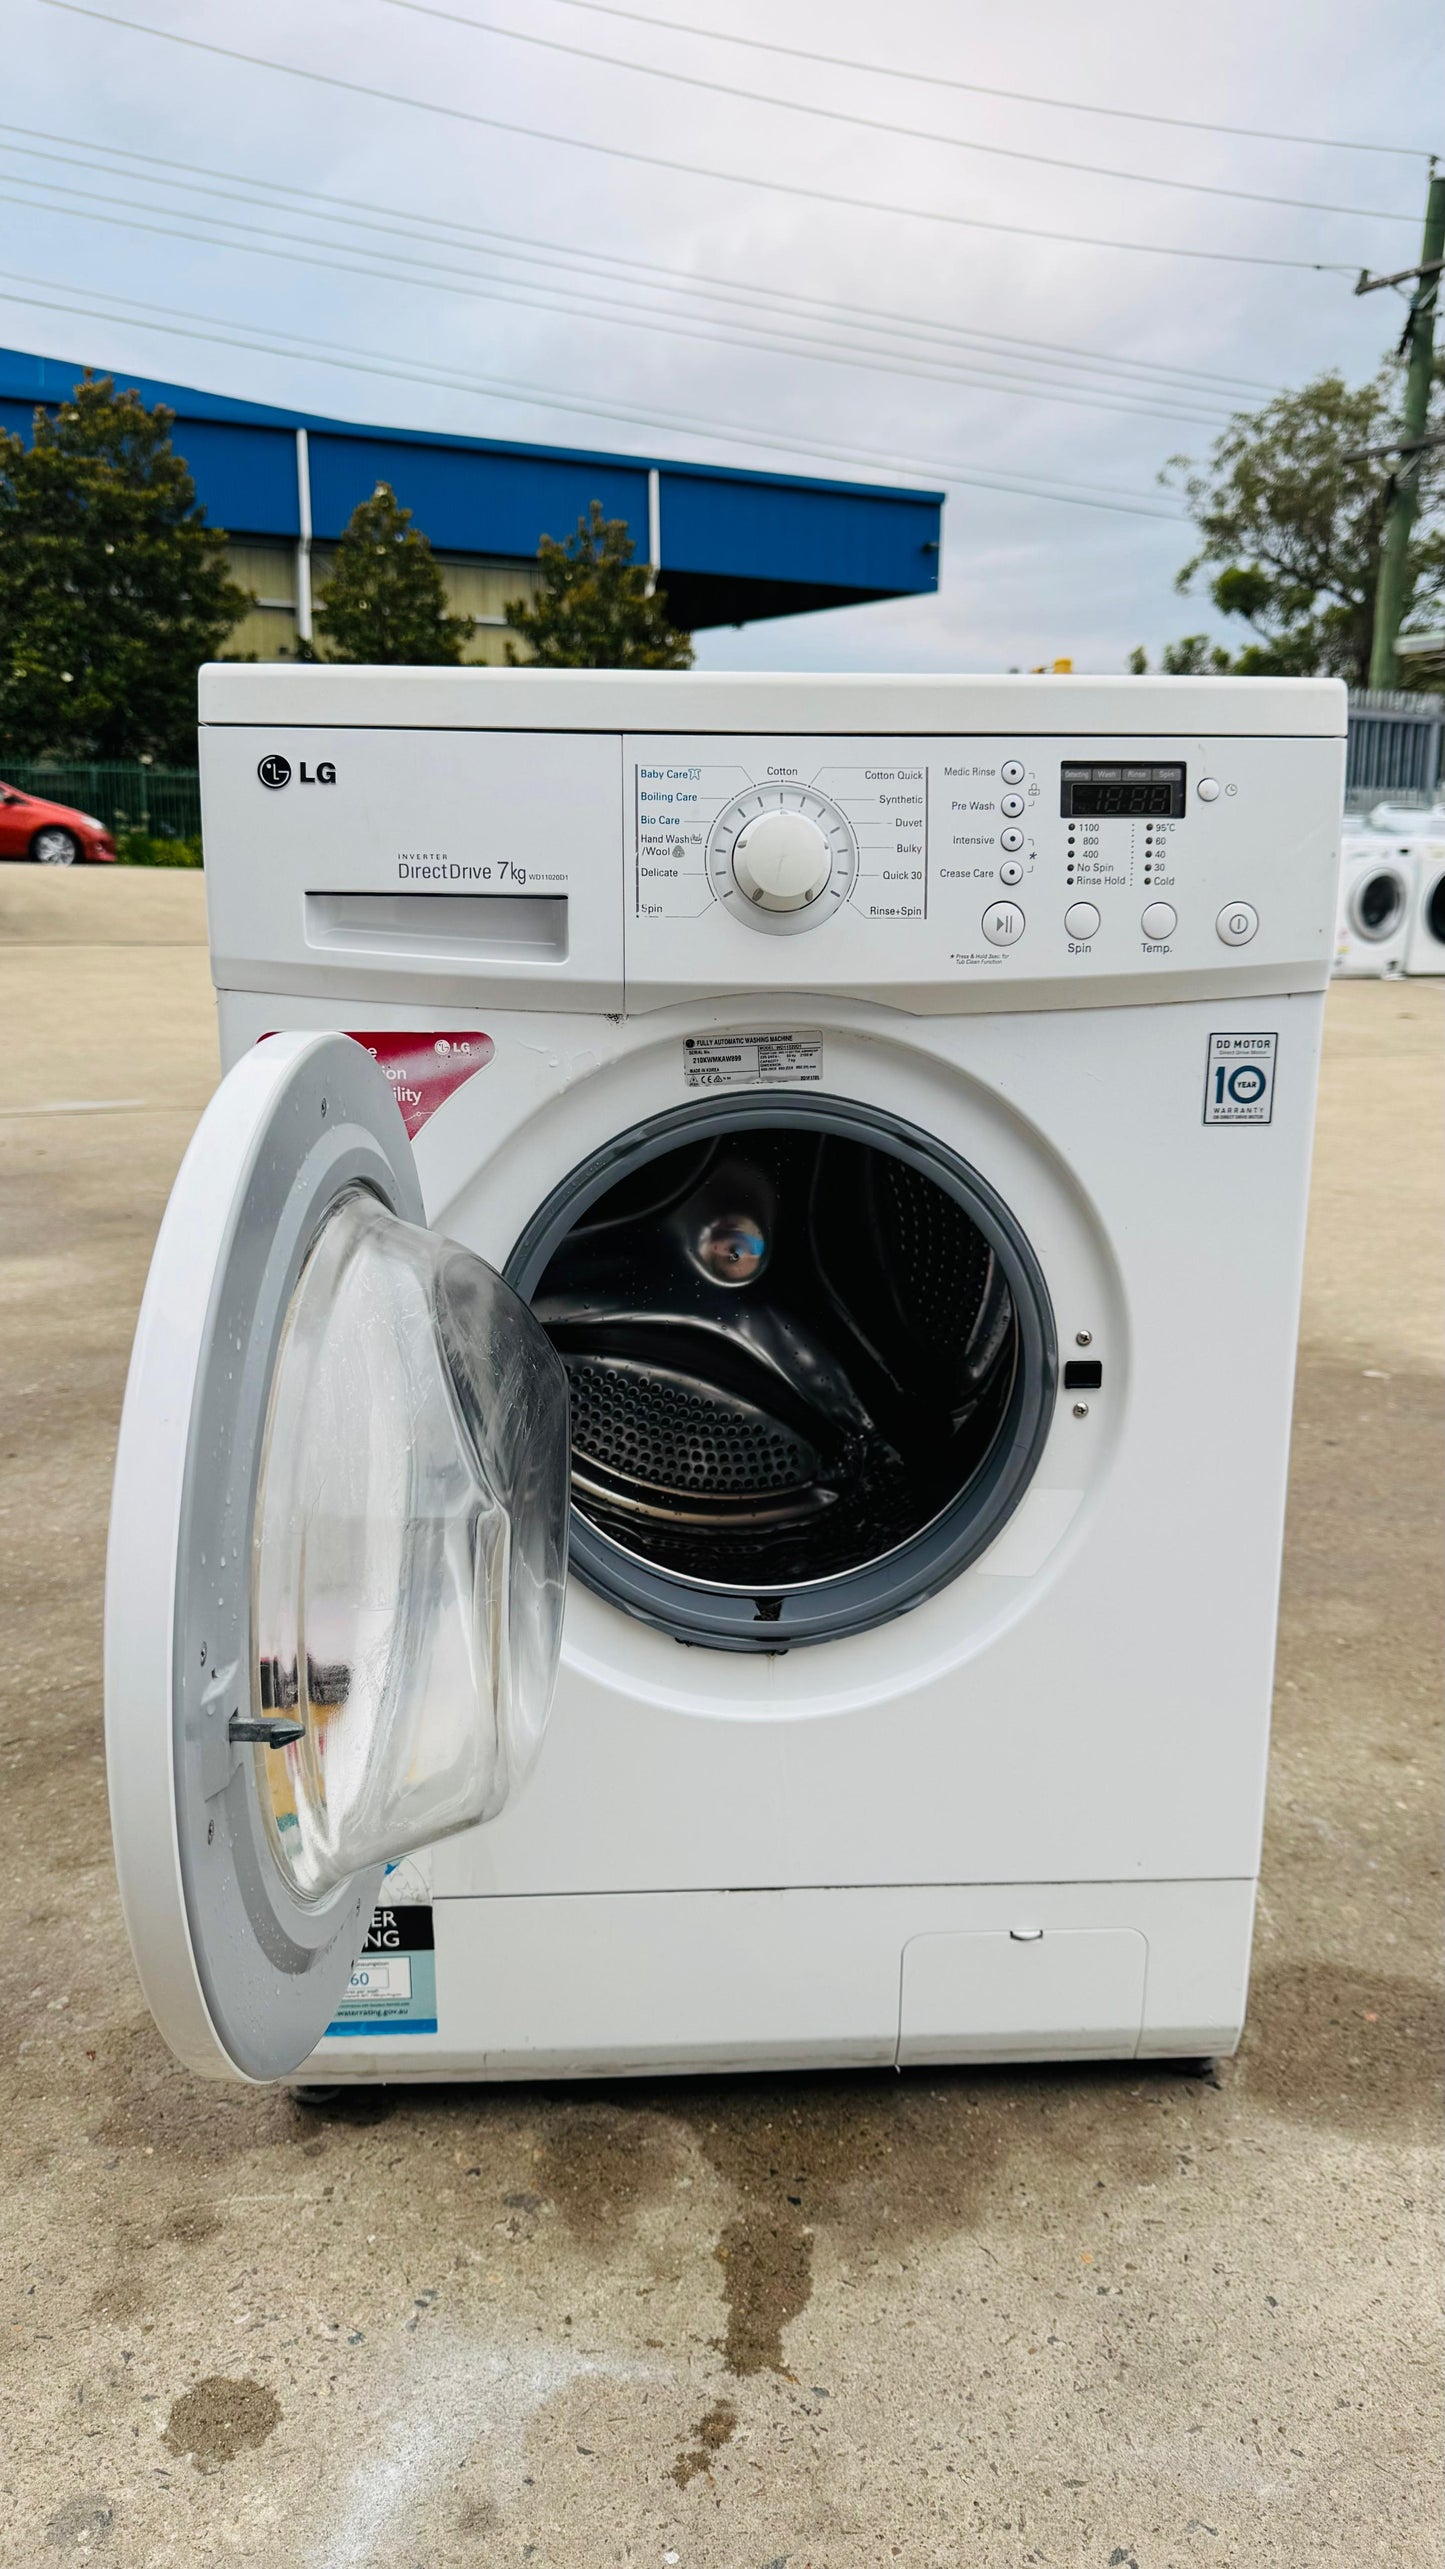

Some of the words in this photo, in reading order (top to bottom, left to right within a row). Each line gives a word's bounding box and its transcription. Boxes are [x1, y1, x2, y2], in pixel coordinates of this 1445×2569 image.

[300, 761, 336, 784] LG
[640, 769, 665, 780] Baby
[667, 770, 688, 779] Care
[767, 766, 798, 777] Cotton
[865, 770, 895, 780] Cotton
[898, 771, 923, 781] Quick
[944, 766, 970, 776] Medic
[972, 767, 996, 776] Rinse
[641, 791, 676, 803] Boiling
[677, 792, 698, 802] Care
[879, 794, 923, 806] Synthetic
[951, 801, 967, 811] Pre
[969, 801, 995, 811] Wash
[641, 815, 657, 825] Bio
[659, 816, 680, 825] Care
[895, 818, 923, 828] Duvet
[1079, 823, 1099, 832] 1100
[640, 834, 662, 844] Hand
[664, 835, 690, 844] Wash
[953, 835, 995, 845] Intensive
[1083, 837, 1099, 845] 800
[1155, 837, 1166, 845] 60
[642, 846, 671, 857] /Wool
[896, 844, 922, 856] Bulky
[1082, 850, 1099, 858] 400
[1155, 850, 1166, 858] 40
[641, 867, 678, 878] Delicate
[1077, 863, 1090, 872] No
[1093, 863, 1114, 873] Spin
[1154, 863, 1165, 872] 30
[882, 870, 909, 881] Quick
[911, 870, 923, 880] 30
[940, 868, 971, 878] Crease
[973, 868, 994, 878] Care
[1076, 876, 1101, 885] Rinse
[1104, 876, 1126, 885] Hold
[1154, 876, 1175, 885] Cold
[641, 903, 663, 914] Spin
[870, 906, 922, 917] Rinse+Spin
[1068, 943, 1092, 955] Spin
[1141, 943, 1173, 955] Temp.
[453, 1042, 470, 1053] LG
[1216, 1040, 1230, 1049] DD
[1233, 1040, 1271, 1048] MOTOR
[1215, 1065, 1266, 1104] 10
